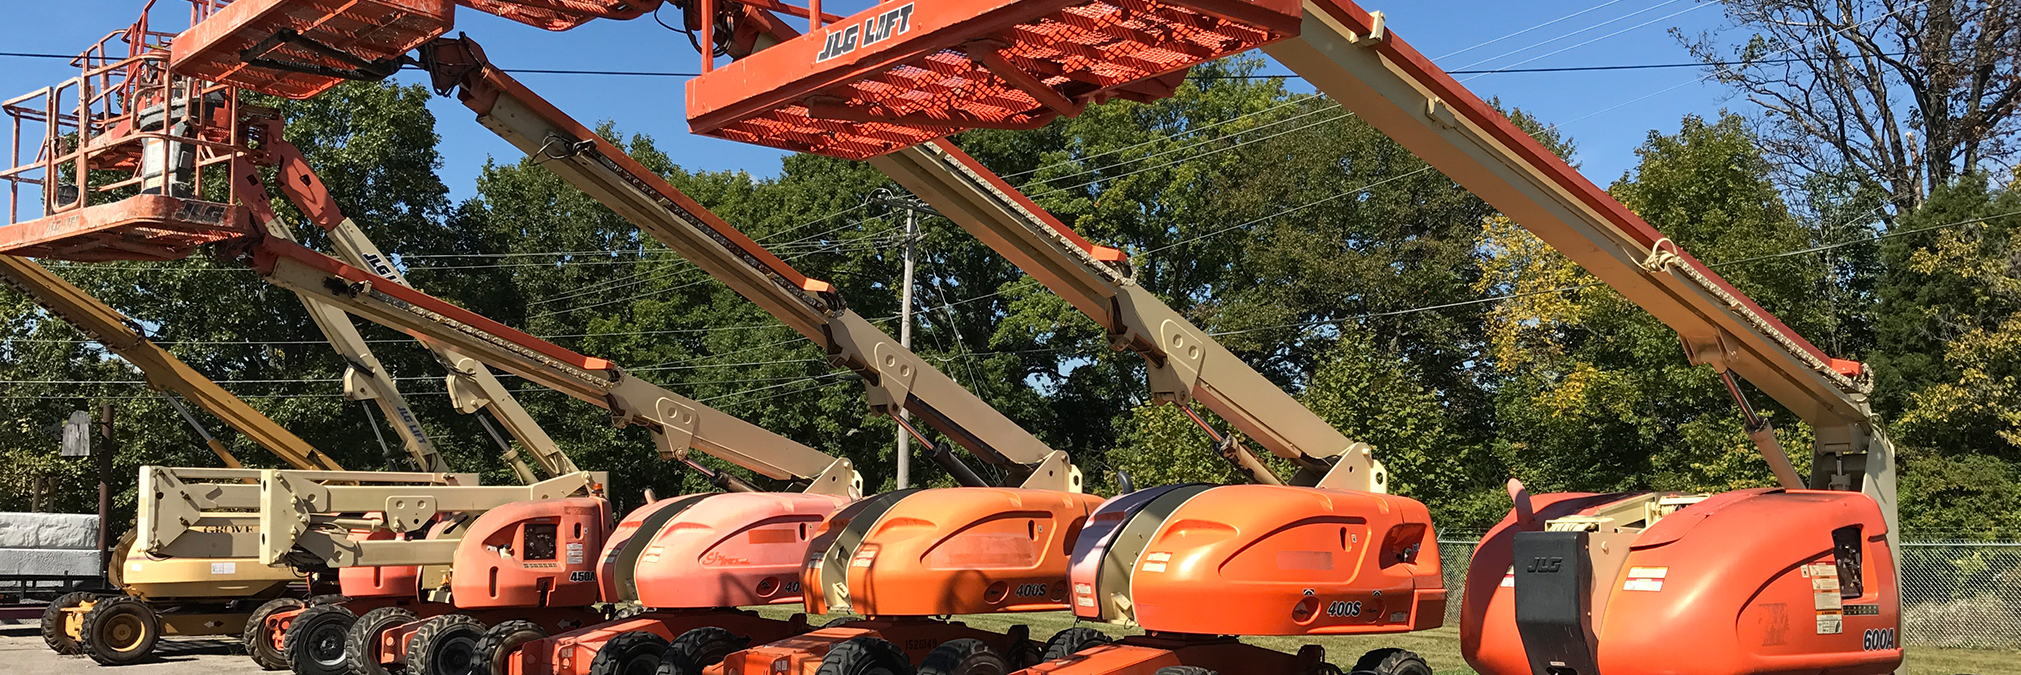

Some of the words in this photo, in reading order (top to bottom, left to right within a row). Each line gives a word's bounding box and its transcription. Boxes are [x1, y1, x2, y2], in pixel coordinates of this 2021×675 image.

[816, 23, 859, 63] JLG
[861, 2, 914, 48] LIFT
[173, 201, 227, 224] JLG
[362, 253, 392, 276] JLG
[396, 406, 413, 422] JLG
[408, 424, 427, 444] LIFT
[204, 525, 254, 534] GROVE
[1527, 556, 1563, 573] JLG
[569, 571, 596, 582] 450A
[784, 581, 802, 593] 40
[1015, 583, 1047, 598] 400S
[1327, 600, 1362, 617] 400S
[1863, 628, 1895, 651] 600A
